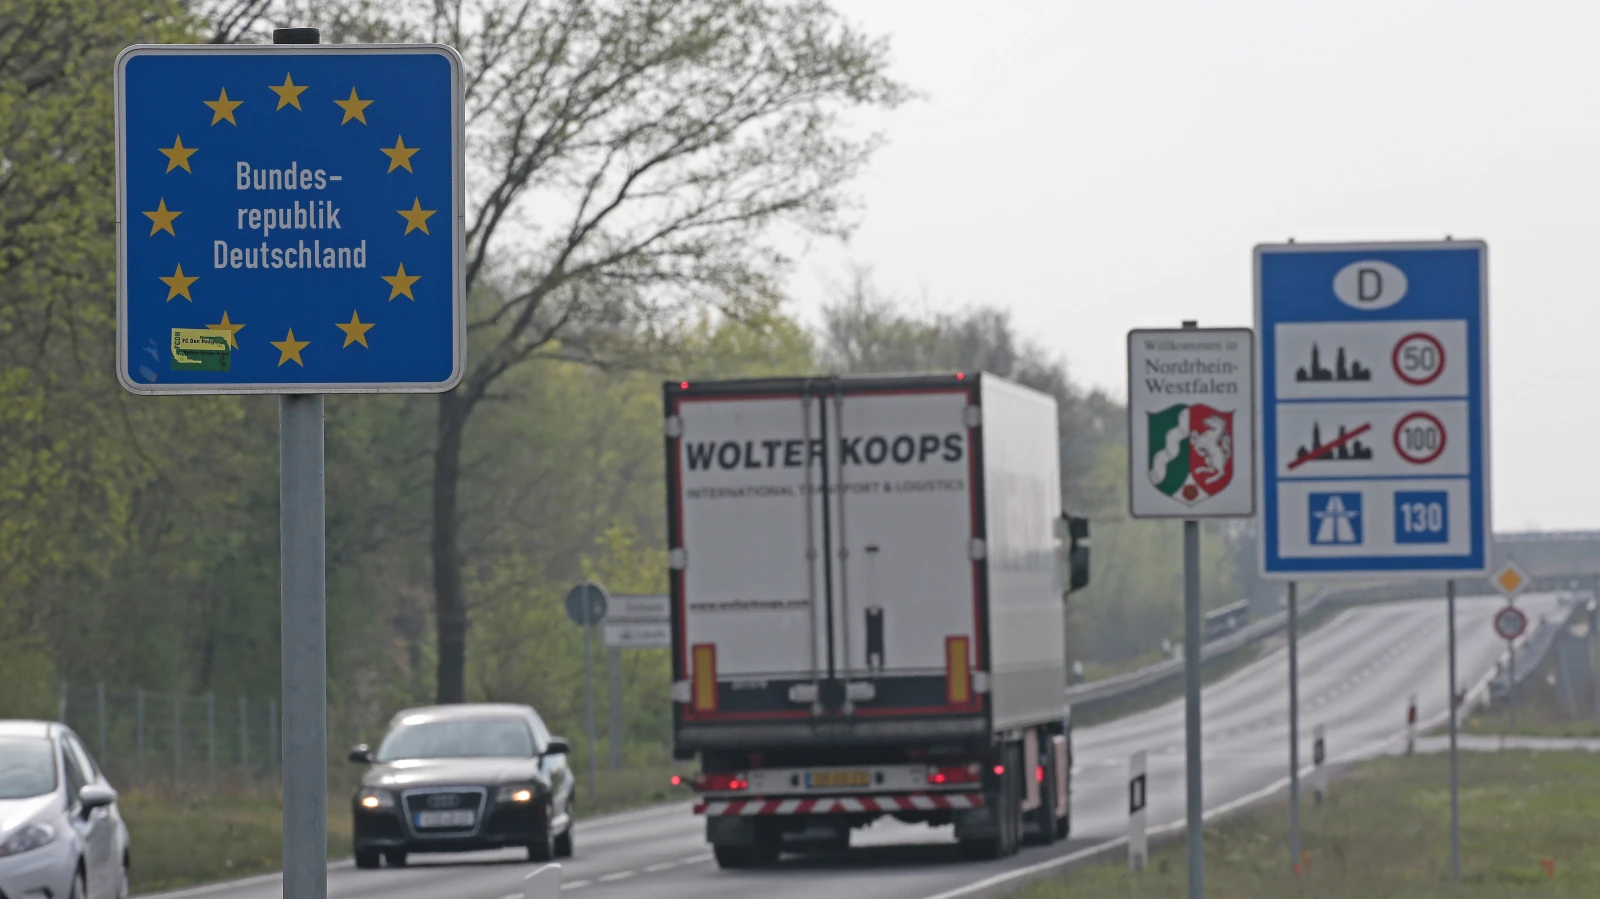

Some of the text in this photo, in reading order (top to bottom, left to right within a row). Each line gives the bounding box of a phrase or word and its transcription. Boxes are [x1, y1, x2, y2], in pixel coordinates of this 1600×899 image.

[236, 161, 342, 190] Bundes-
[237, 200, 341, 237] republik
[213, 240, 367, 269] Deutschland
[1357, 268, 1383, 302] D
[1143, 340, 1238, 351] Willkommen in
[1403, 346, 1436, 371] 50
[1144, 358, 1239, 375] Nordrhein-
[1144, 377, 1238, 395] Westfalen
[686, 433, 963, 471] WOLTER KOOPS
[1404, 427, 1437, 451] 100
[687, 484, 794, 500] INTERNATIONAL
[884, 481, 892, 494] &
[896, 479, 965, 494] LOGISTICS
[1400, 503, 1442, 533] 130
